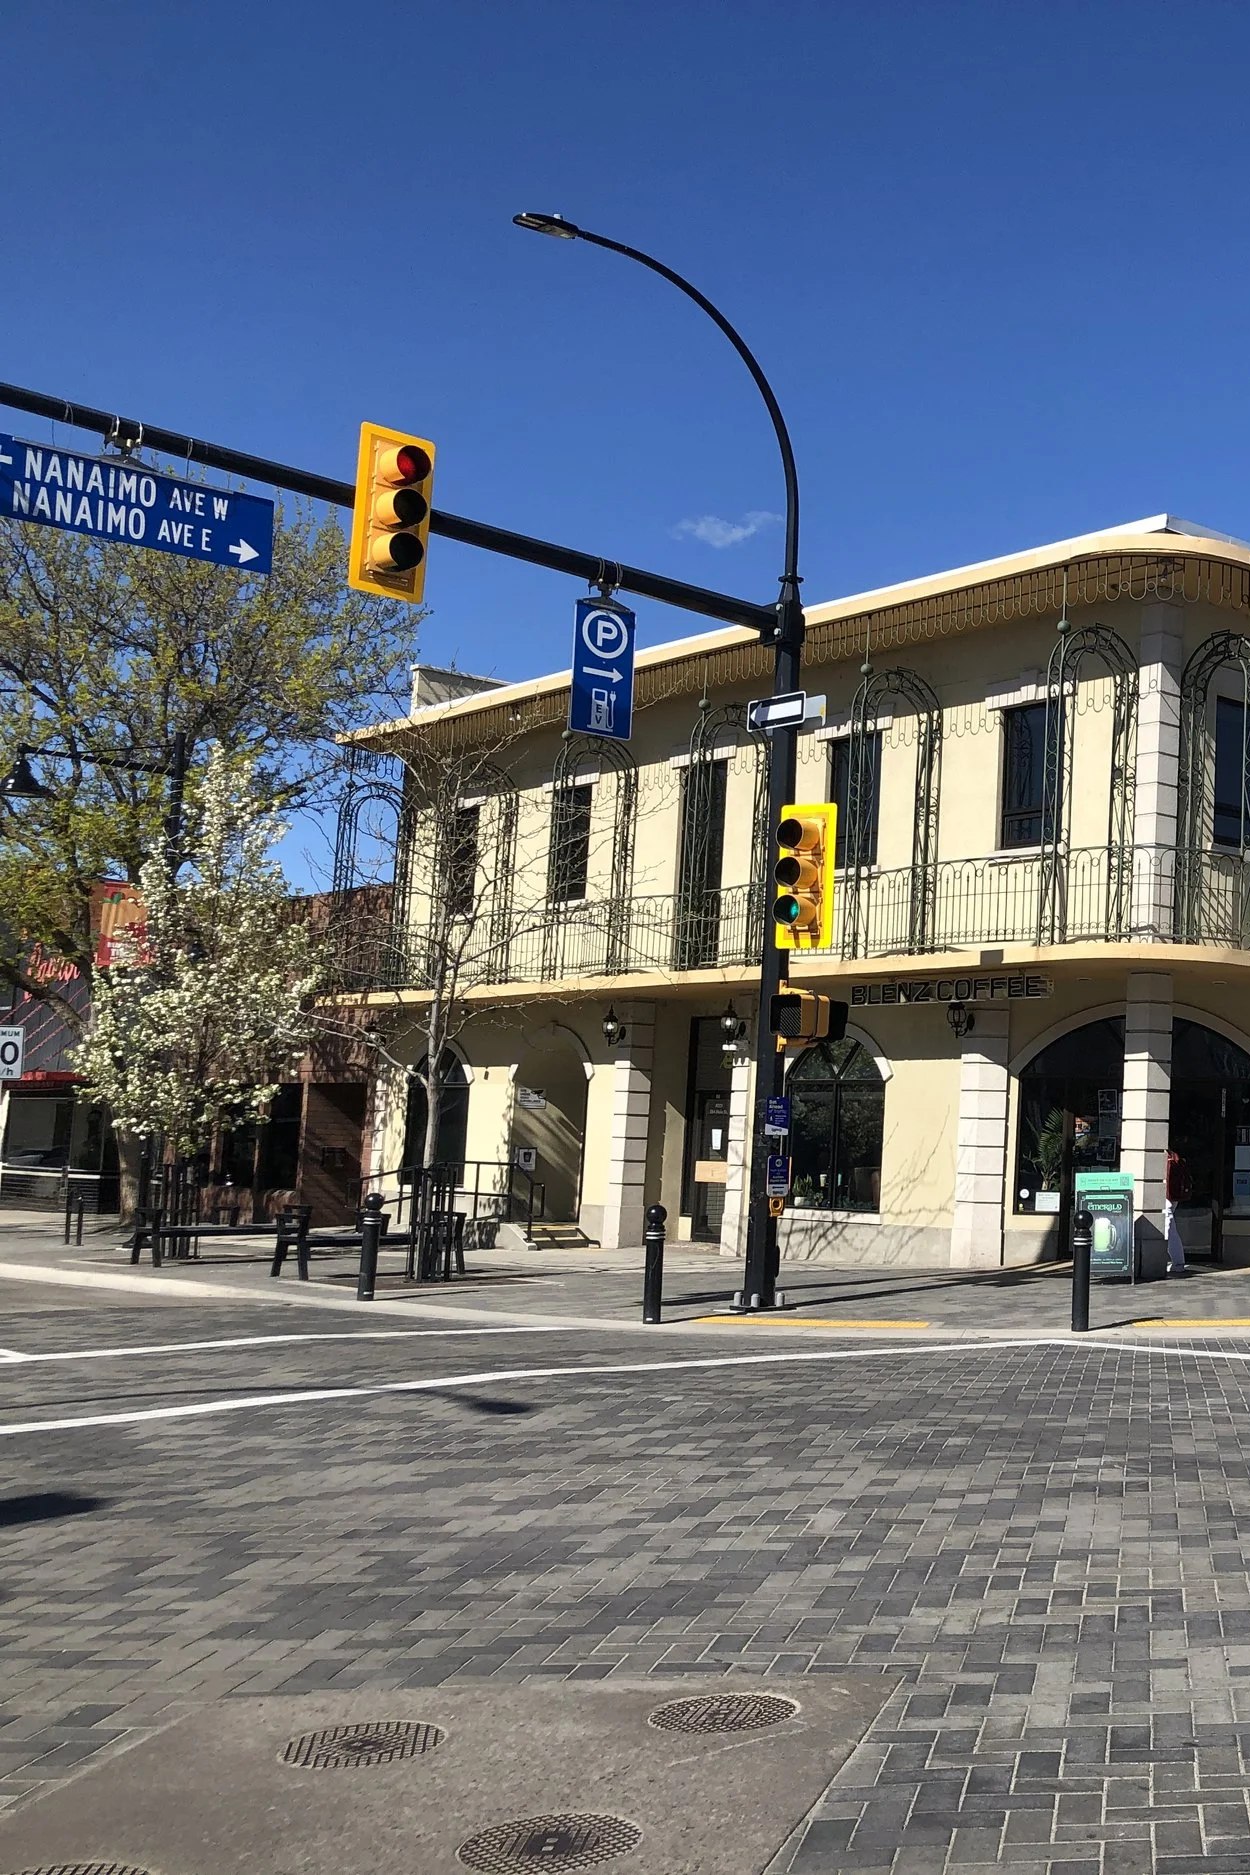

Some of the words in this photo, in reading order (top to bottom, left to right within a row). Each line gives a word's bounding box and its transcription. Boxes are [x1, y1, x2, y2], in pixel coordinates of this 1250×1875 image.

[25, 447, 157, 508] NANAIMO
[170, 487, 206, 517] AVE
[213, 499, 229, 521] W
[13, 480, 146, 540] NANAIMO
[157, 519, 194, 548] AVE
[201, 528, 212, 552] E
[597, 619, 618, 647] P
[851, 981, 931, 1006] BLENZ
[935, 975, 1042, 1001] COFFEE
